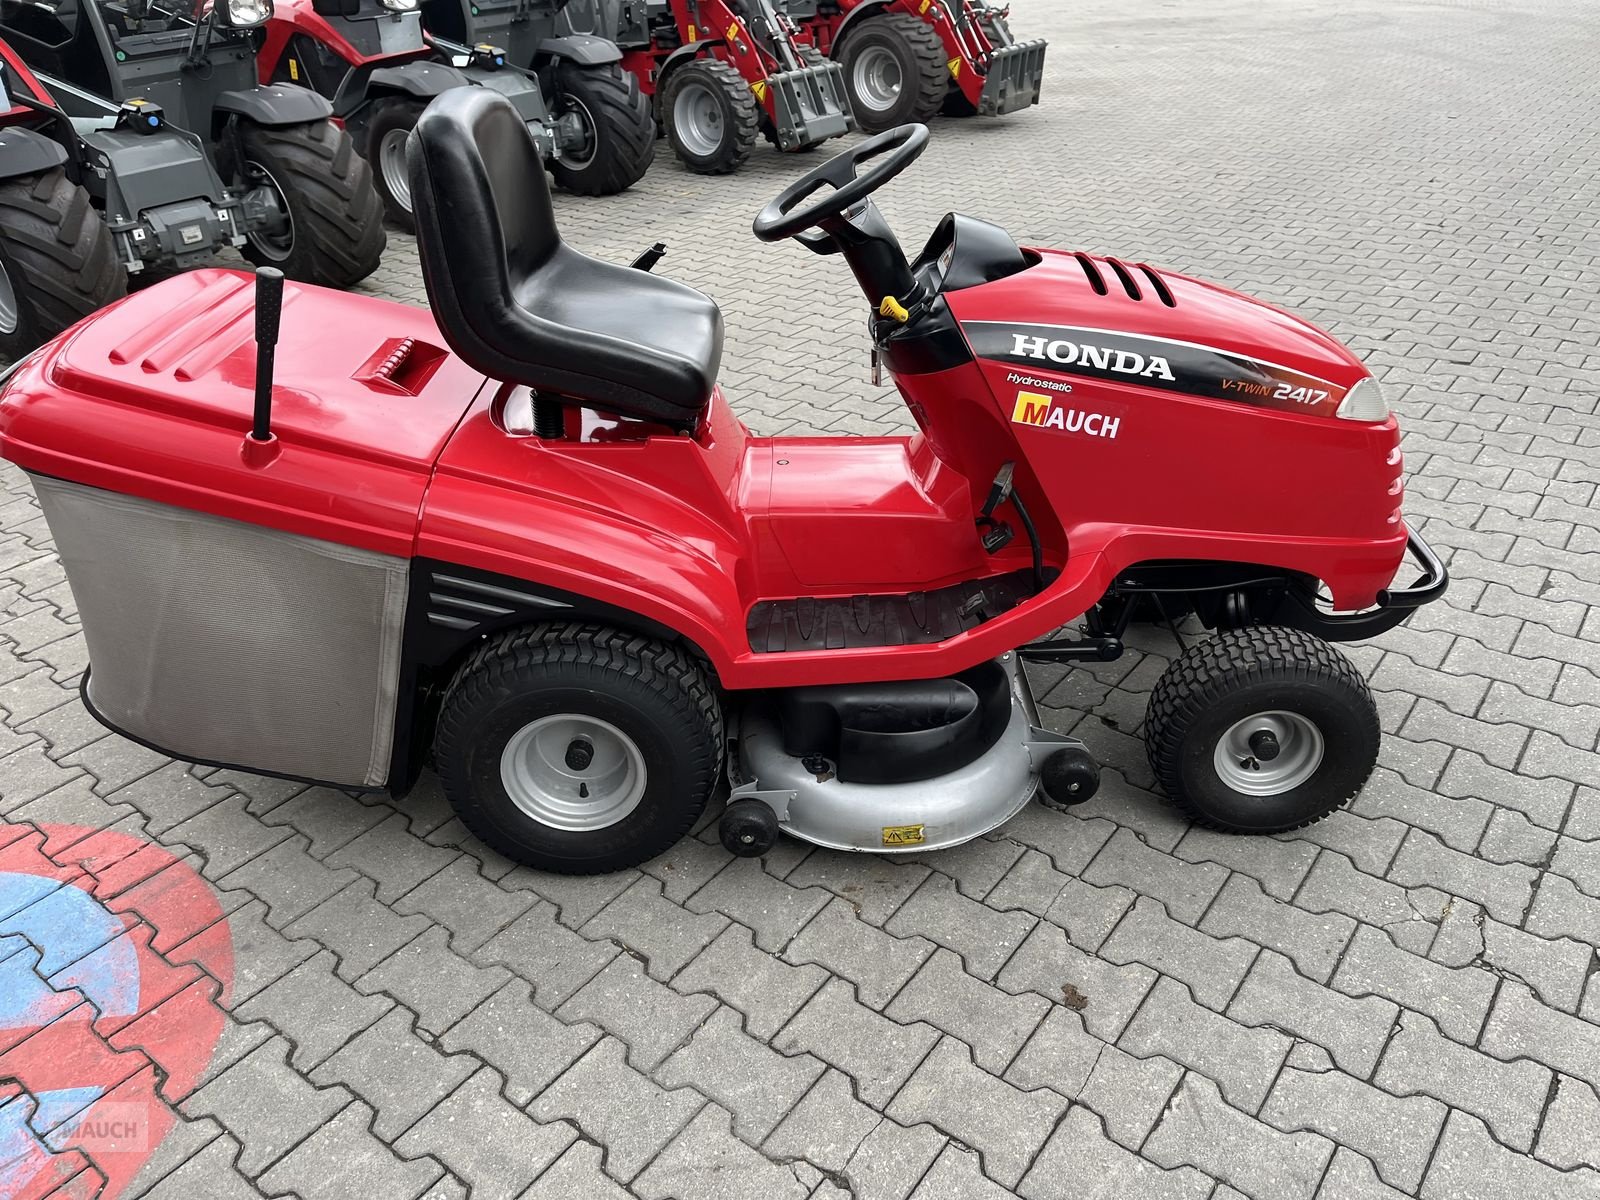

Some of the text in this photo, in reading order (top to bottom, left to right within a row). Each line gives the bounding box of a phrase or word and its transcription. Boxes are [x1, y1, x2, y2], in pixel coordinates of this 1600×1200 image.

[1010, 333, 1176, 381] HONDA
[1007, 372, 1072, 393] Hydrostatic
[1222, 379, 1328, 405] V-TWIN 2417
[1022, 402, 1120, 438] MAUCH
